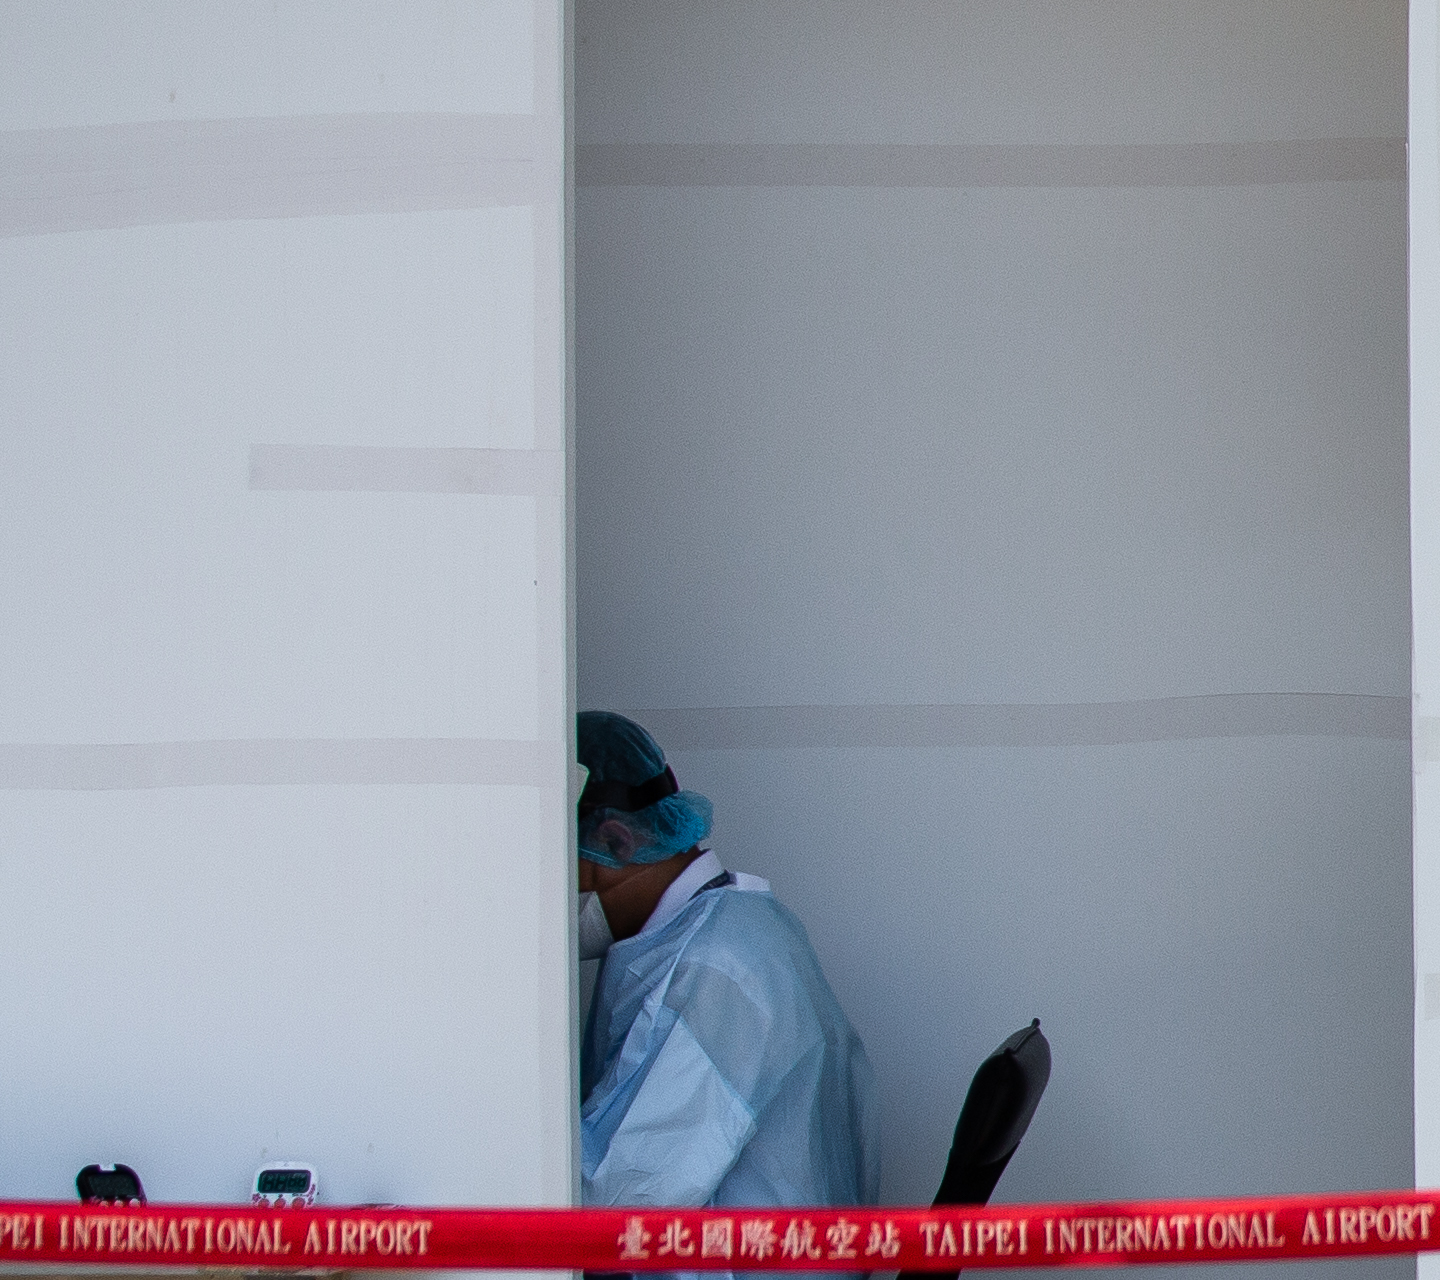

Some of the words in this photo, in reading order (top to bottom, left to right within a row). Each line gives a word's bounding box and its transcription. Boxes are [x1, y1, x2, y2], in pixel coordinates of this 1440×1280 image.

[59, 1214, 291, 1254] INTERNATIONAL
[303, 1220, 433, 1255] AIRPORT
[617, 1216, 901, 1261] 臺北國際航空站
[919, 1219, 1029, 1257] TAIPEI
[1043, 1211, 1286, 1254] INTERNATIONAL
[1302, 1203, 1435, 1246] AIRPORT
